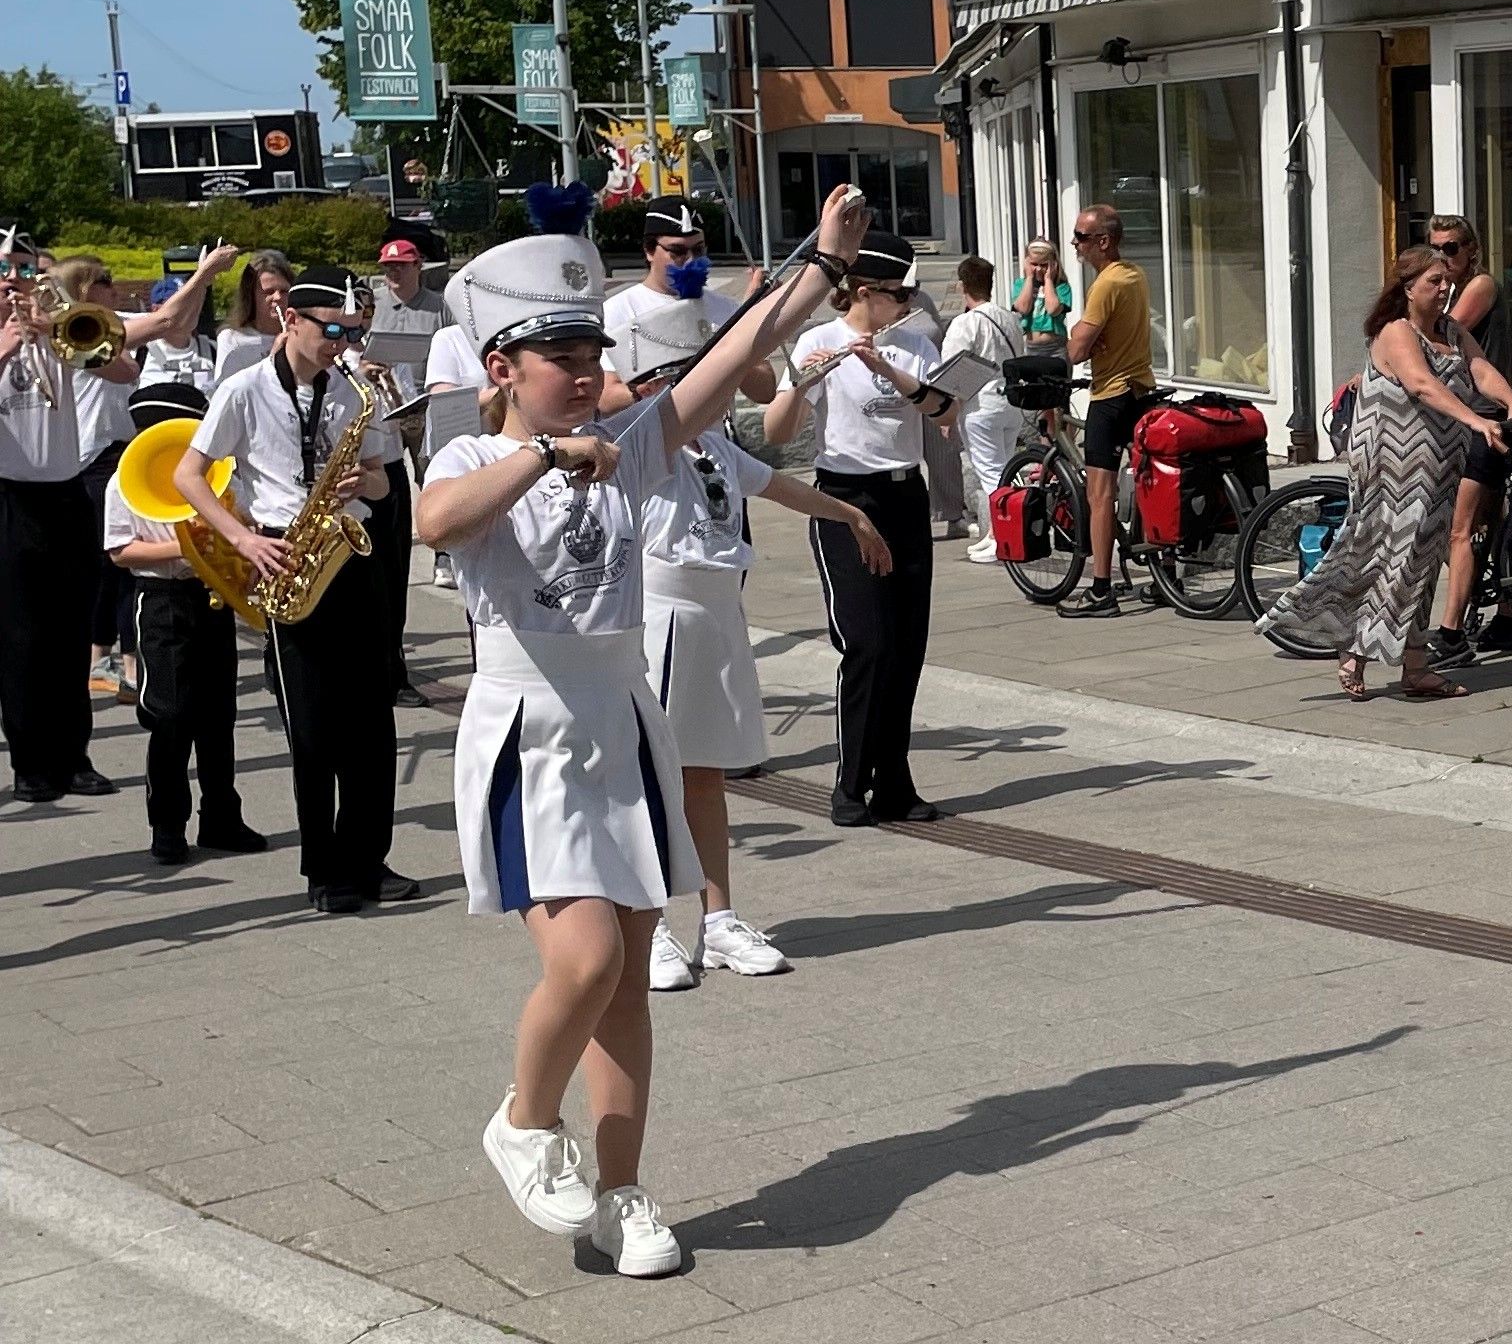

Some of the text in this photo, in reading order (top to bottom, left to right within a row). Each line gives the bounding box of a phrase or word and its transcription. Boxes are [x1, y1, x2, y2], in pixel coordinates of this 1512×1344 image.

[354, 0, 414, 31] SMAA
[357, 33, 416, 70] FOLK
[361, 77, 419, 95] FESTIVALEN
